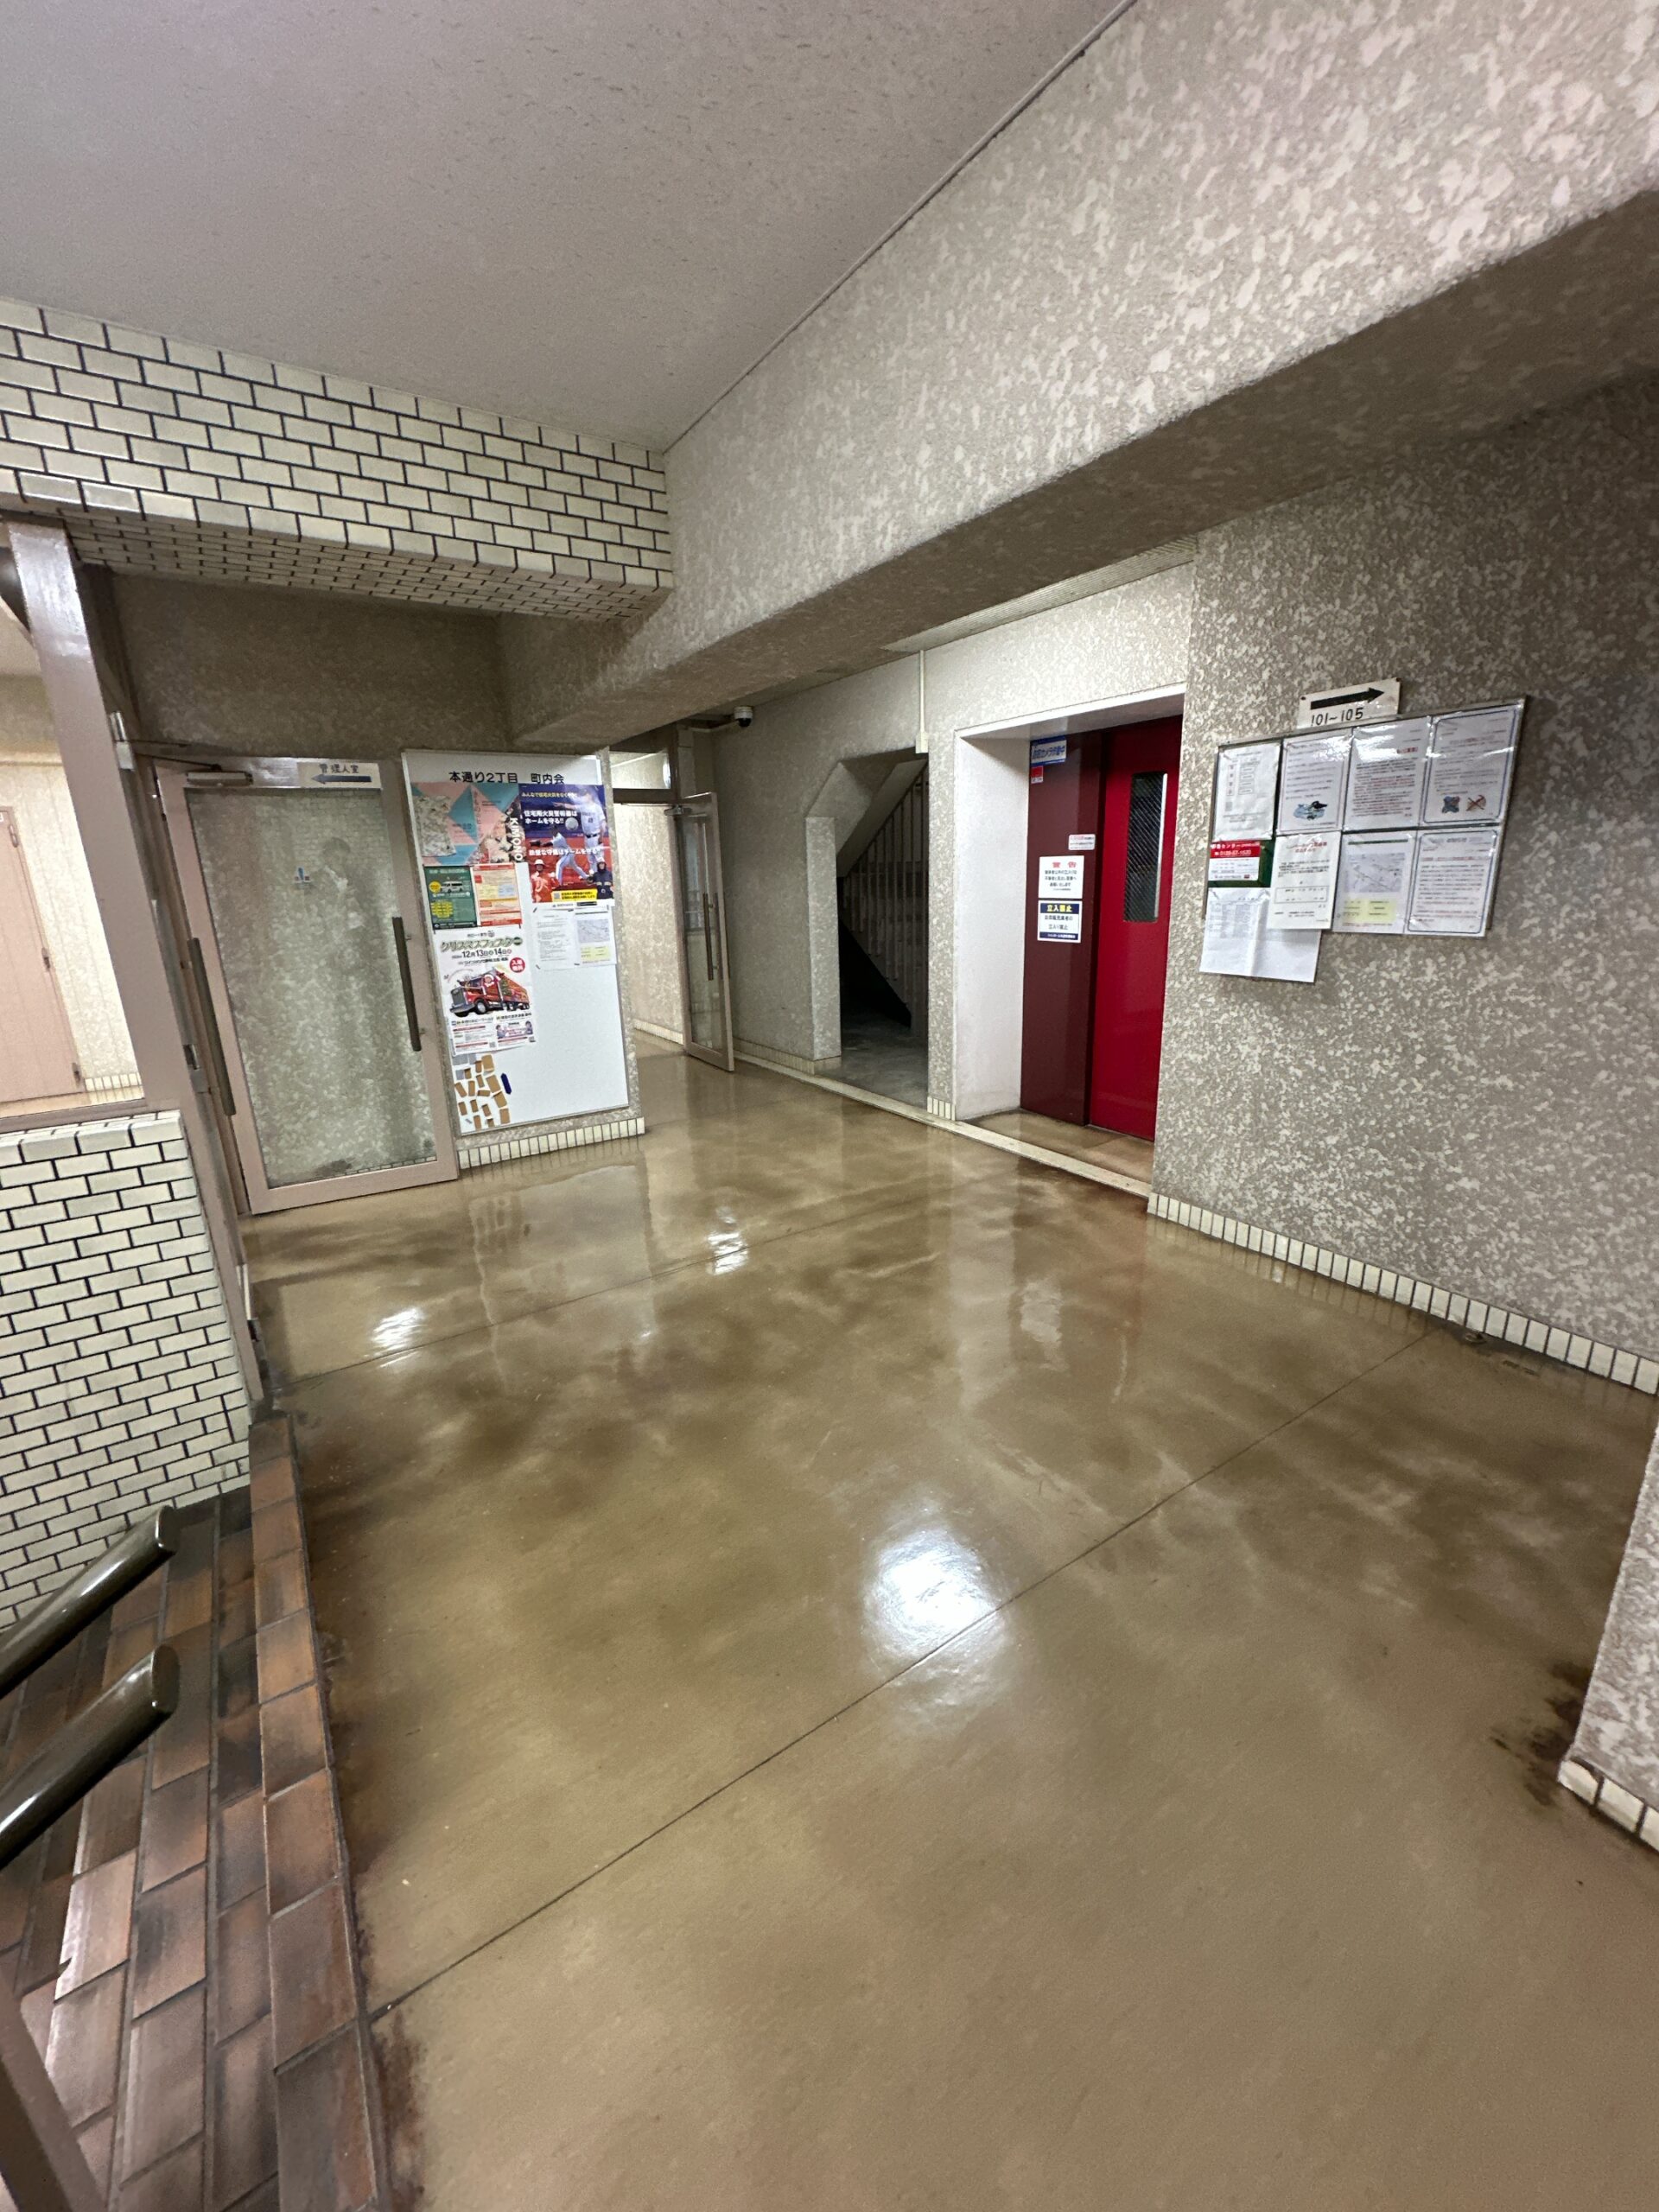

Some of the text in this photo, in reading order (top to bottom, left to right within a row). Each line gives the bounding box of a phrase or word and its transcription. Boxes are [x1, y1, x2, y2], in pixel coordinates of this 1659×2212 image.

[319, 763, 359, 774] 管理人室
[448, 771, 564, 785] 本通り2丁目 町内会
[510, 817, 524, 861] KIMONO
